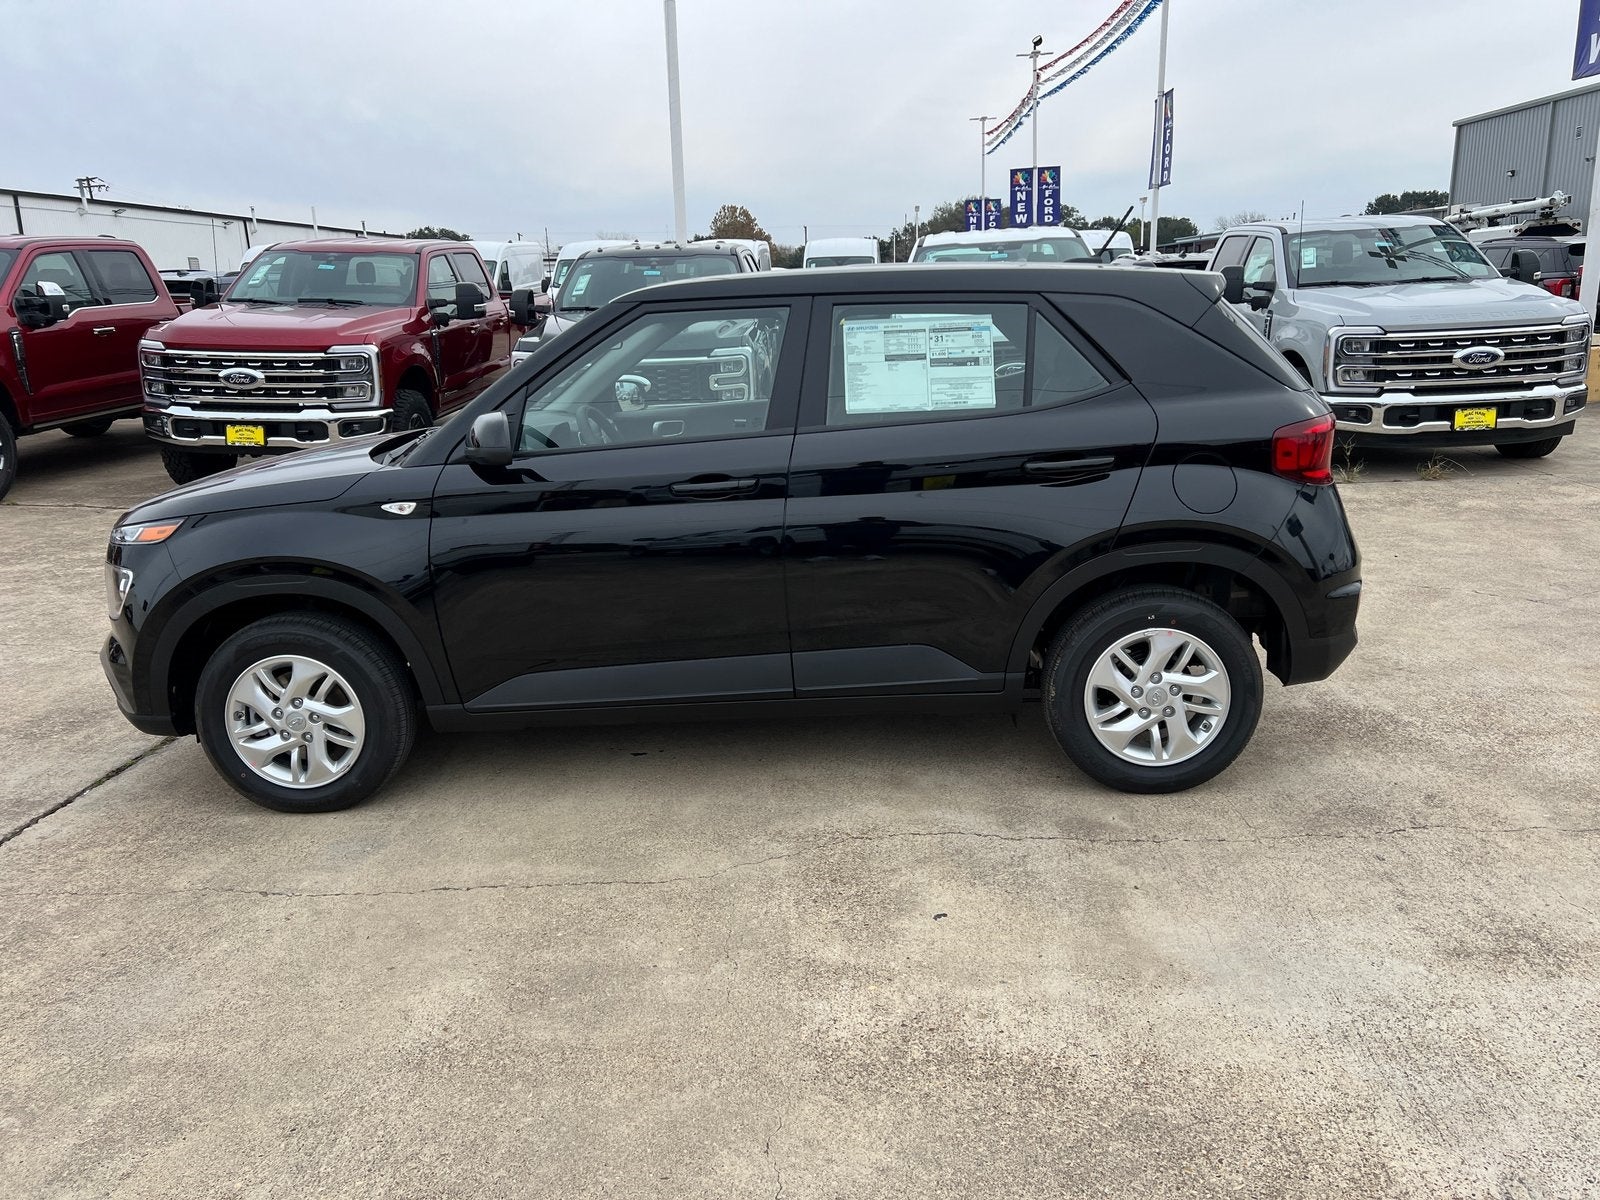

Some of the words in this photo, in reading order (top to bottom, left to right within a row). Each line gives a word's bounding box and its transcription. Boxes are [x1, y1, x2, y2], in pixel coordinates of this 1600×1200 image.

[1163, 129, 1171, 182] FORD
[1015, 191, 1027, 224] NEW
[1043, 190, 1054, 222] FORD
[969, 216, 977, 231] NE
[1408, 312, 1483, 322] SUPER
[1488, 309, 1541, 319] DUTY
[934, 335, 944, 343] 31
[1468, 352, 1493, 363] Ford
[229, 373, 251, 384] Ford
